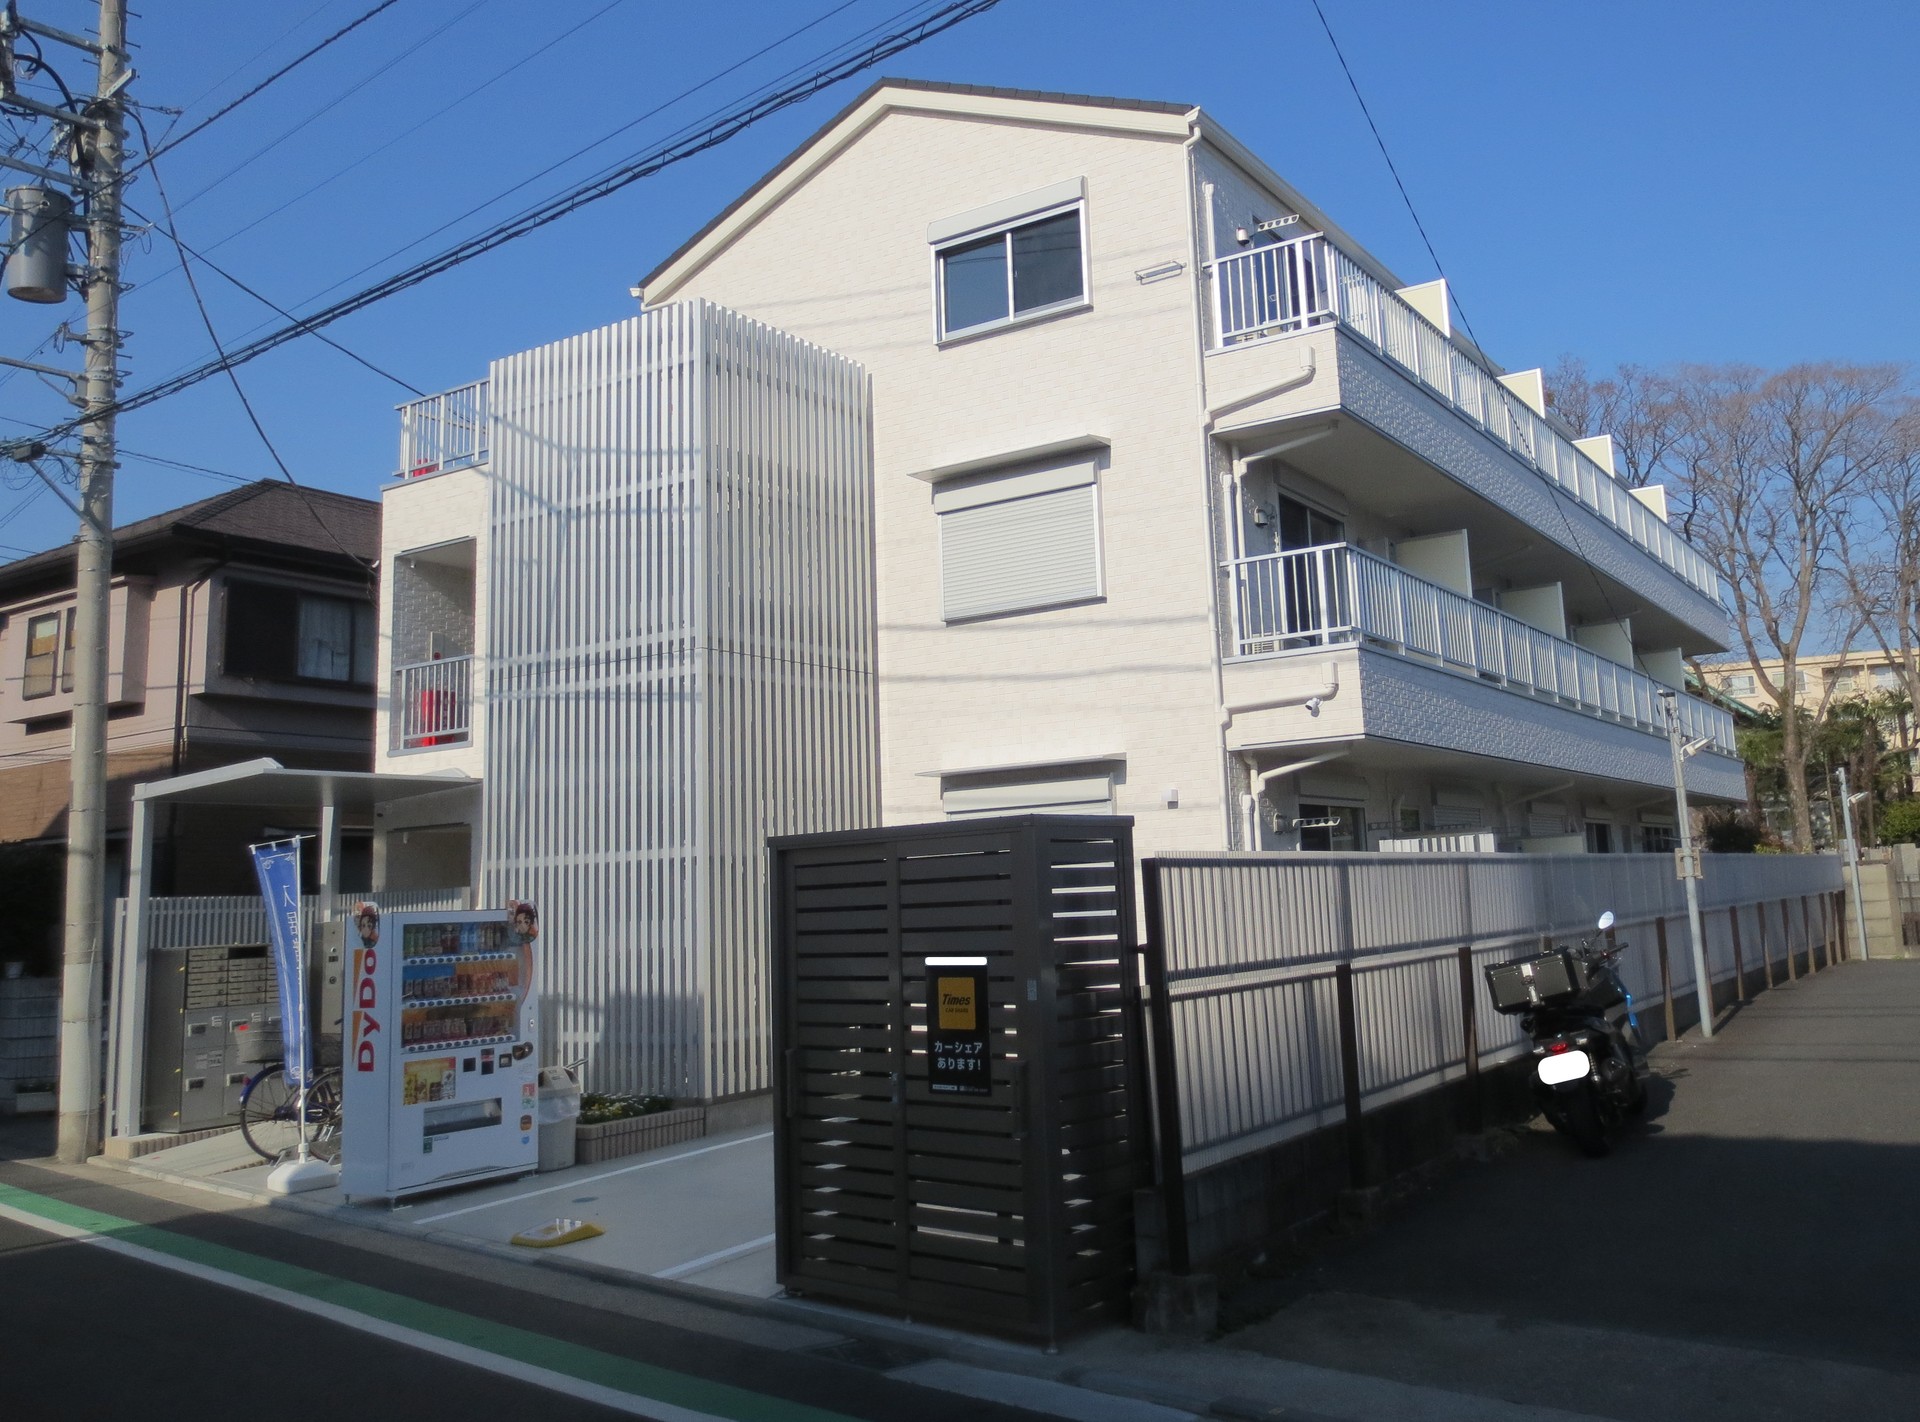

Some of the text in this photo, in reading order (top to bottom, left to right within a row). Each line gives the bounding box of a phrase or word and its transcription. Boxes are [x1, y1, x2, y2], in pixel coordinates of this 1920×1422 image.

[942, 994, 971, 1006] Times
[934, 1041, 983, 1054] カーシェア
[937, 1057, 981, 1071] あります!
